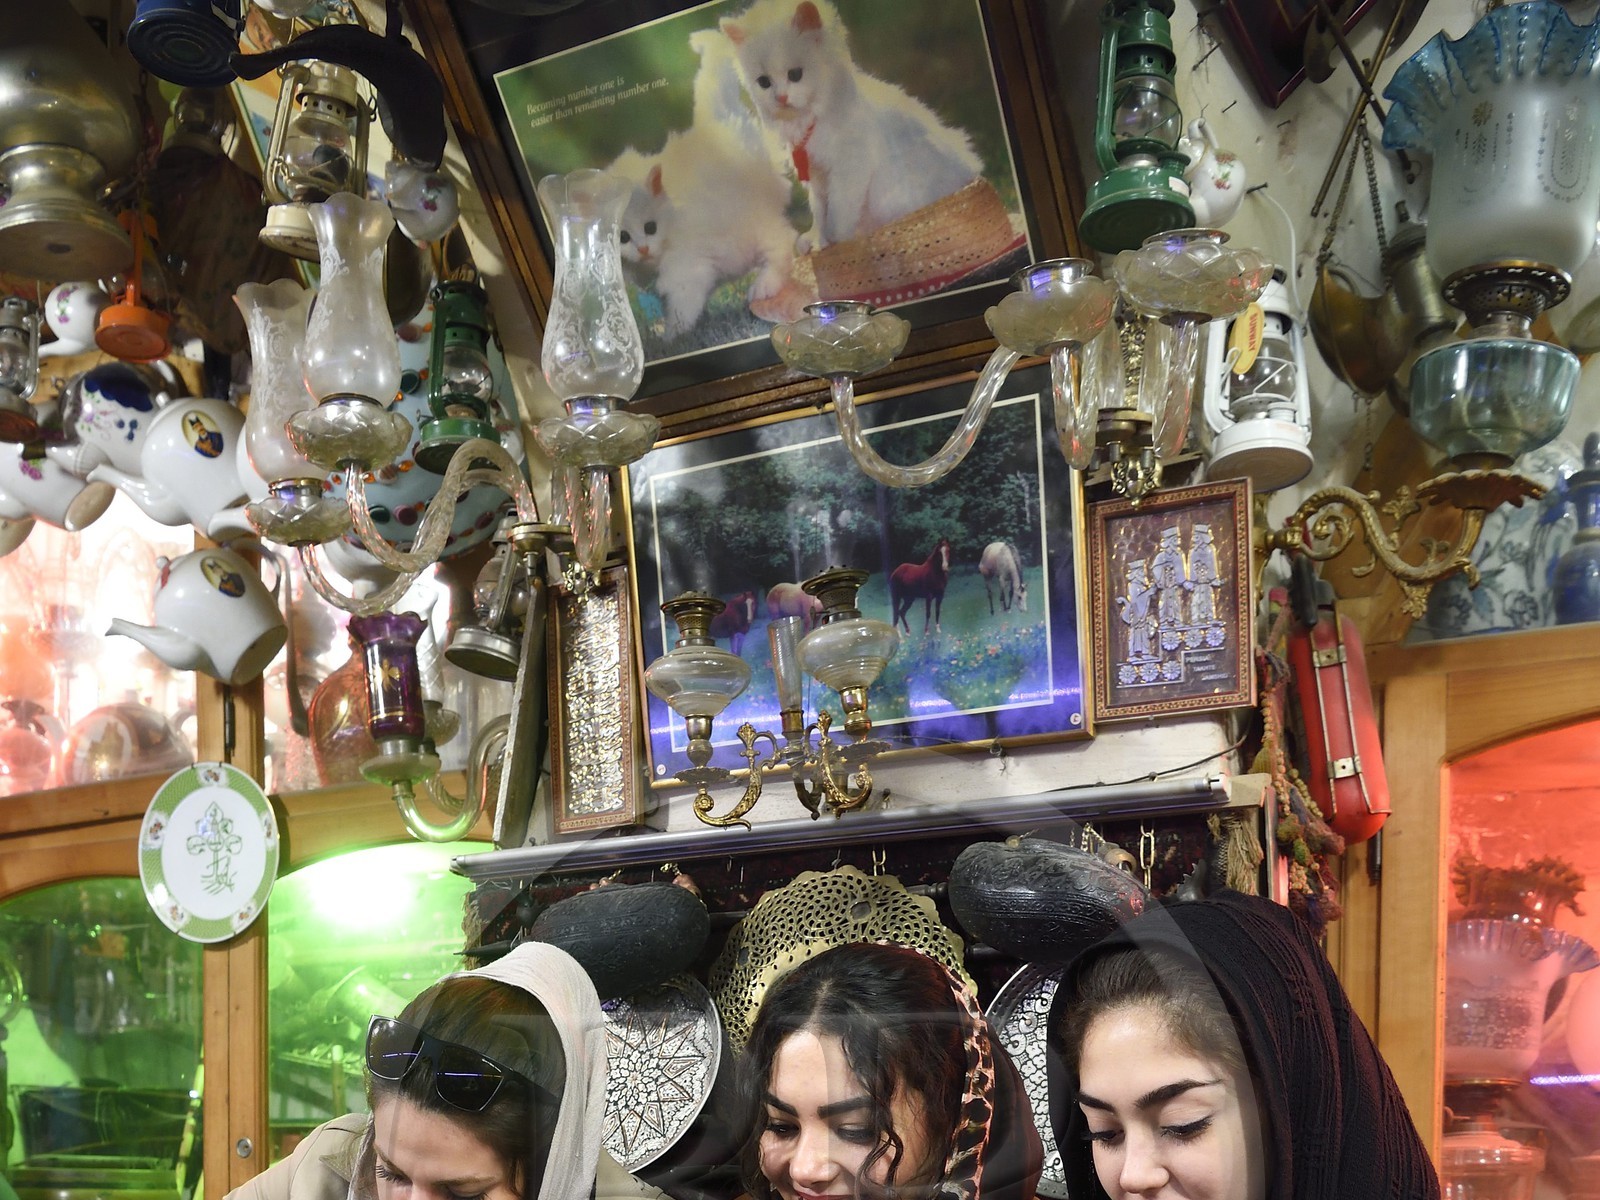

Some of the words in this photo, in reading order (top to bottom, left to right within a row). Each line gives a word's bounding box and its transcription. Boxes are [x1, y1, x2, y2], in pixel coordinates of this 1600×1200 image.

[526, 95, 566, 115] Becoming
[568, 85, 598, 101] number
[599, 80, 615, 92] one
[616, 75, 625, 86] is
[530, 113, 554, 128] easier
[555, 108, 573, 120] than
[575, 94, 615, 114] remaining
[618, 82, 650, 100] number
[651, 77, 669, 89] one.
